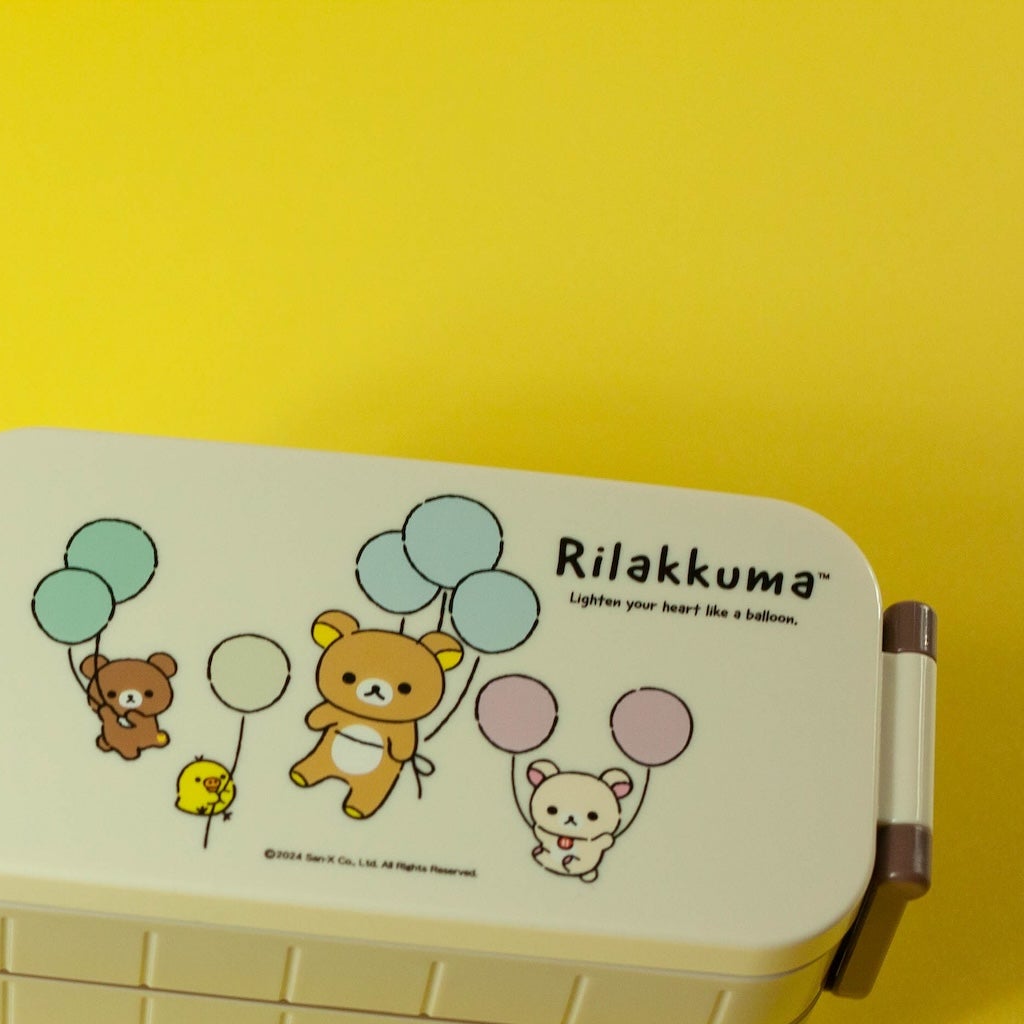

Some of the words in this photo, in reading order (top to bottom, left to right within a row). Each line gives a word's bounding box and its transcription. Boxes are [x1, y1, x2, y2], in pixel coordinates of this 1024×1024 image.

[569, 591, 622, 609] Lighten
[626, 599, 658, 612] your
[662, 597, 702, 617] heart
[705, 604, 729, 619] like
[733, 610, 741, 620] a
[746, 608, 799, 626] balloon.
[359, 858, 378, 869] Ltd.
[381, 860, 394, 870] All
[396, 861, 427, 874] Rights
[430, 865, 478, 878] Reserved.
